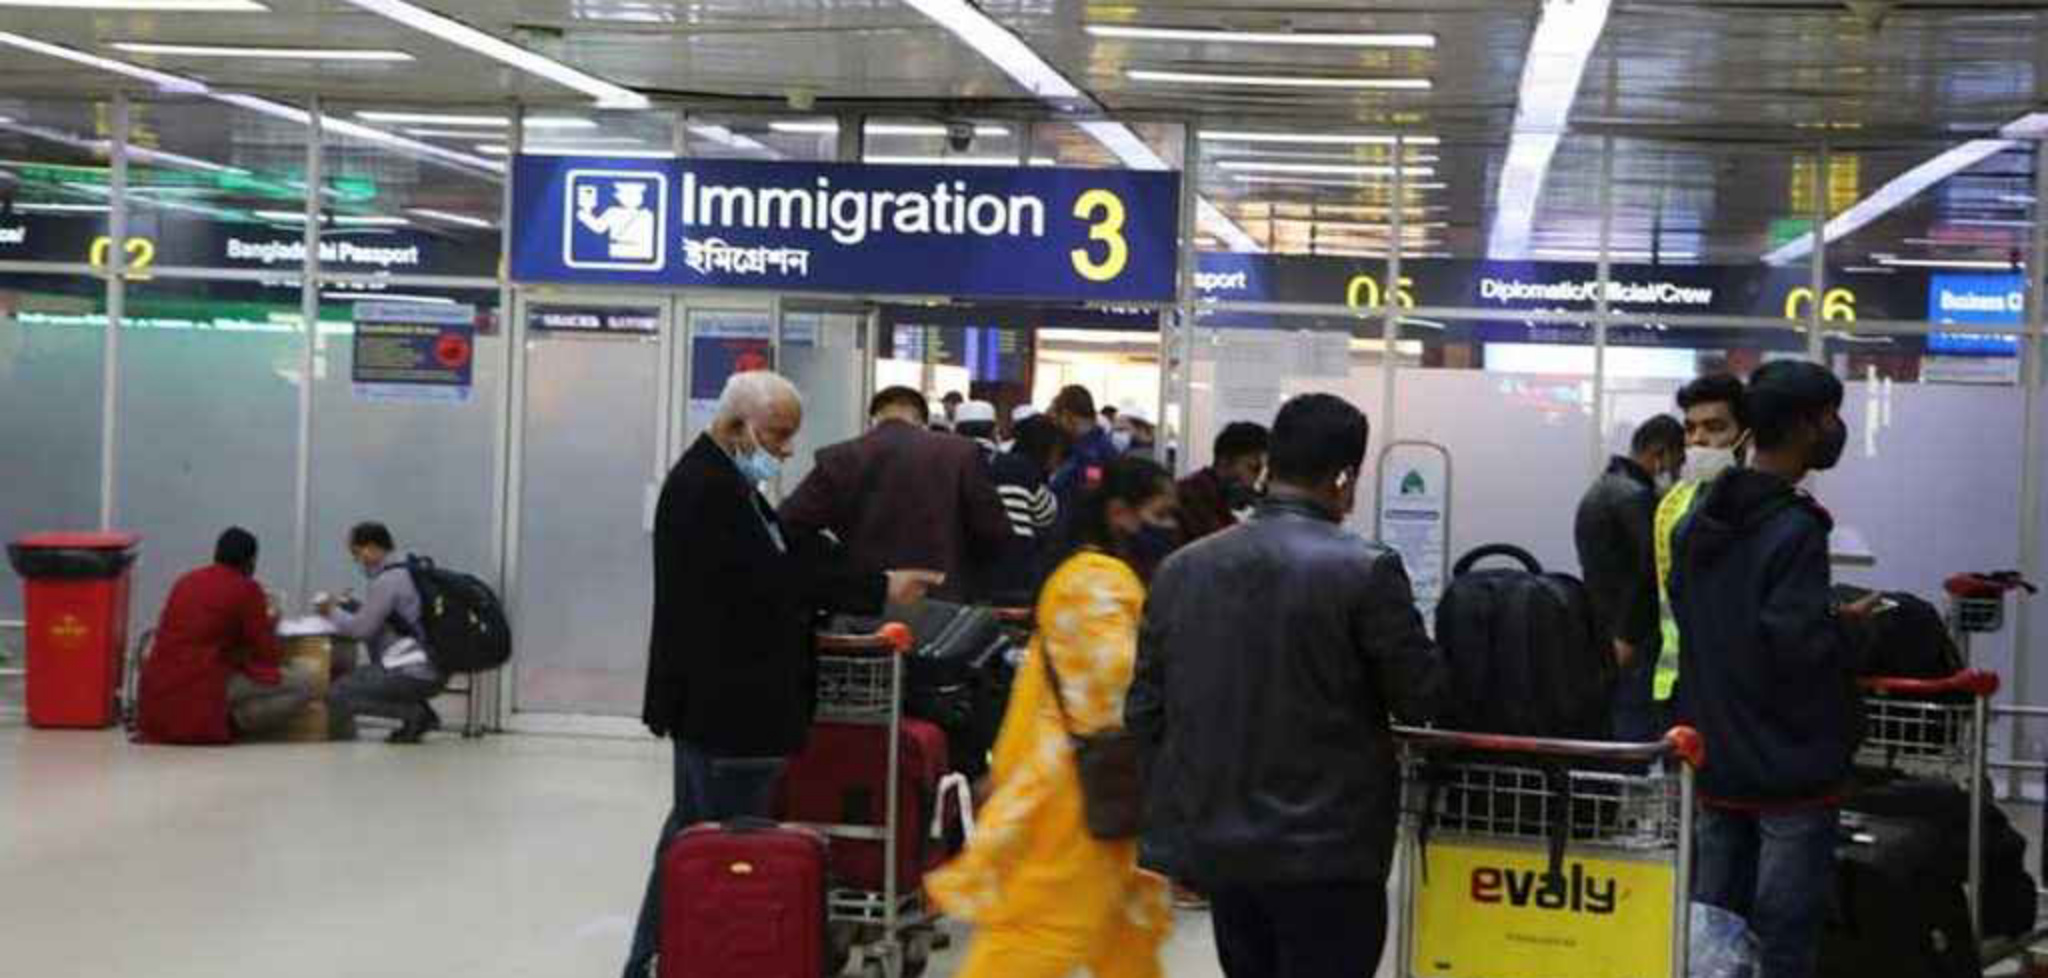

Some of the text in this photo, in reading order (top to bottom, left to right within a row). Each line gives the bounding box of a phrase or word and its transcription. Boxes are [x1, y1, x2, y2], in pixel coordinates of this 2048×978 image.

[682, 172, 1129, 282] Immigration 3
[338, 241, 419, 266] Passport
[682, 236, 810, 276] ইমিগ্রেশন
[1471, 863, 1616, 915] evaly
